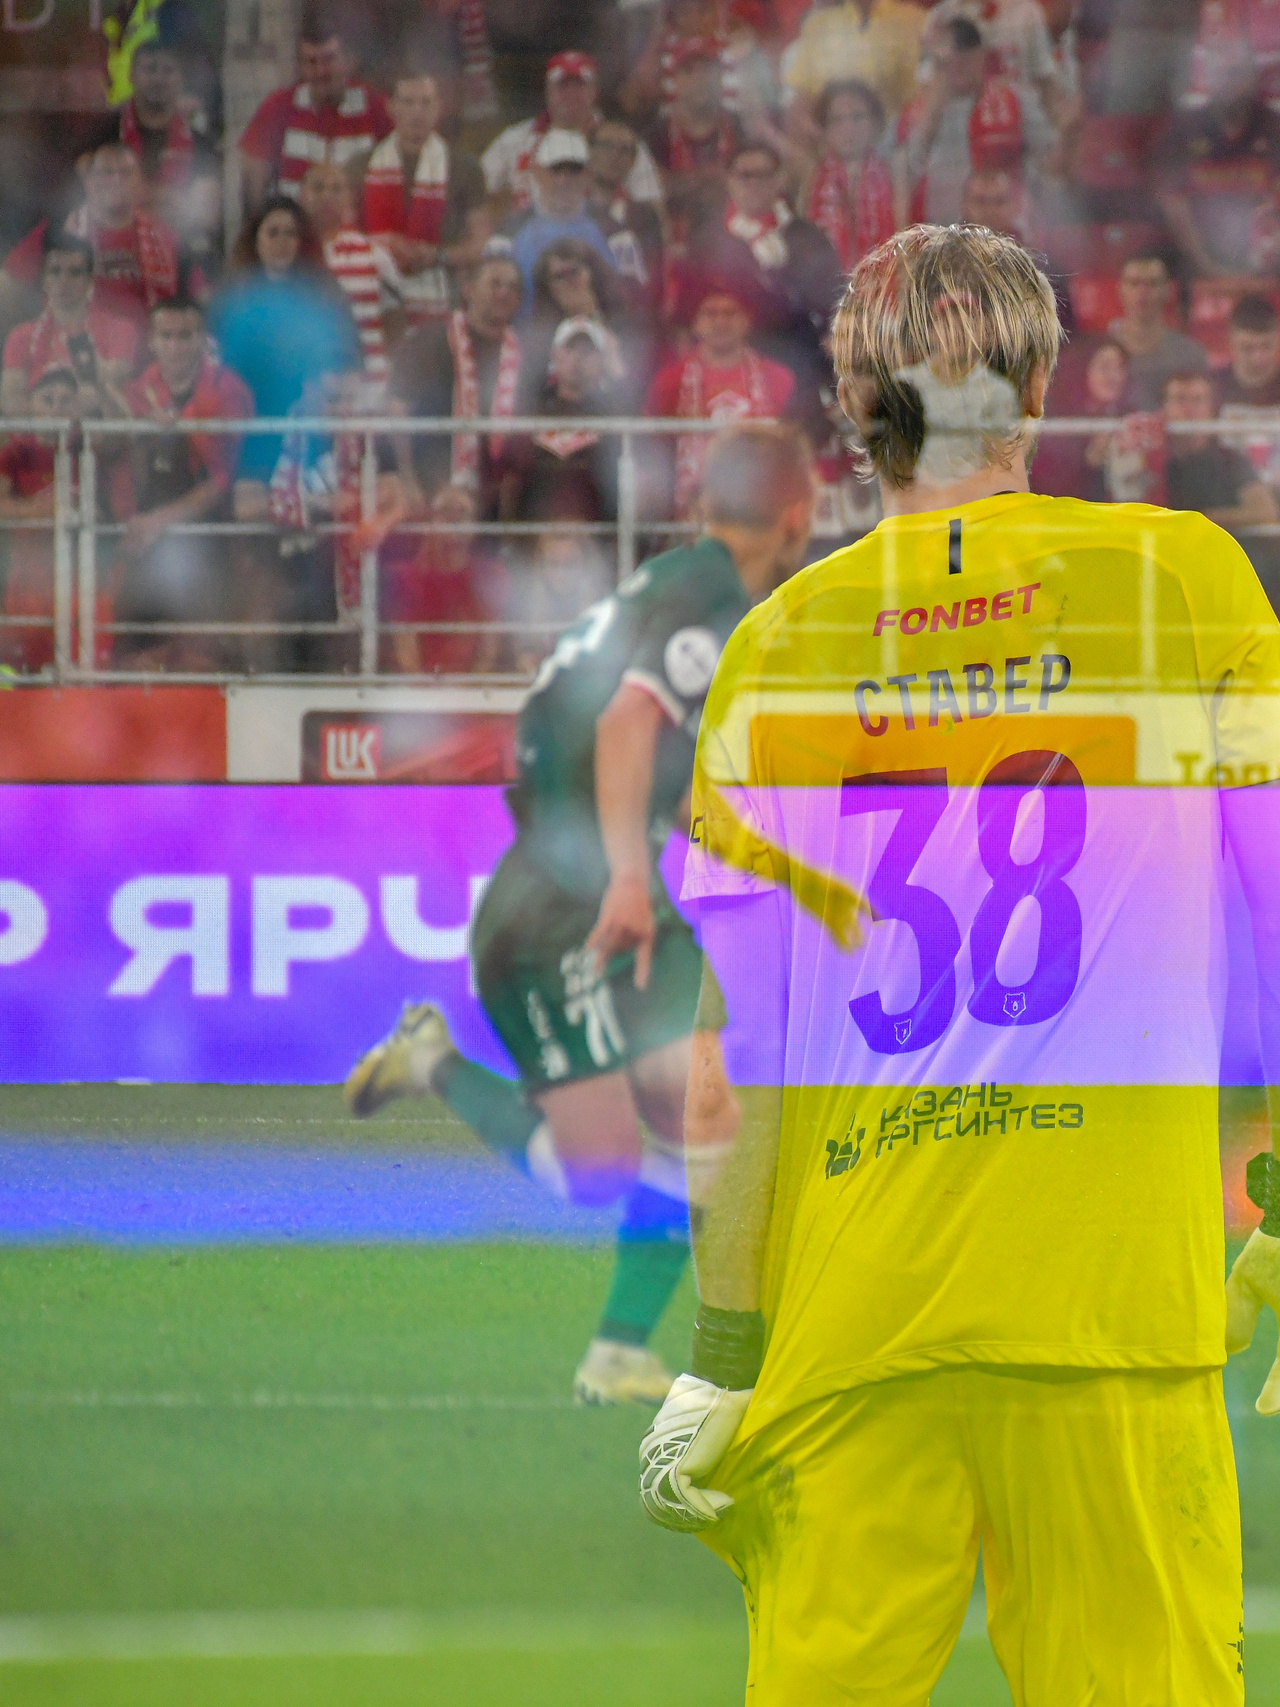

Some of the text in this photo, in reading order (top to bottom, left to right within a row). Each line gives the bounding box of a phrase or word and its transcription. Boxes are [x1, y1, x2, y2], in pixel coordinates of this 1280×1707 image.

[872, 582, 1042, 637] FONBET
[853, 654, 1072, 738] СТАВЕР
[839, 749, 1088, 1056] 38
